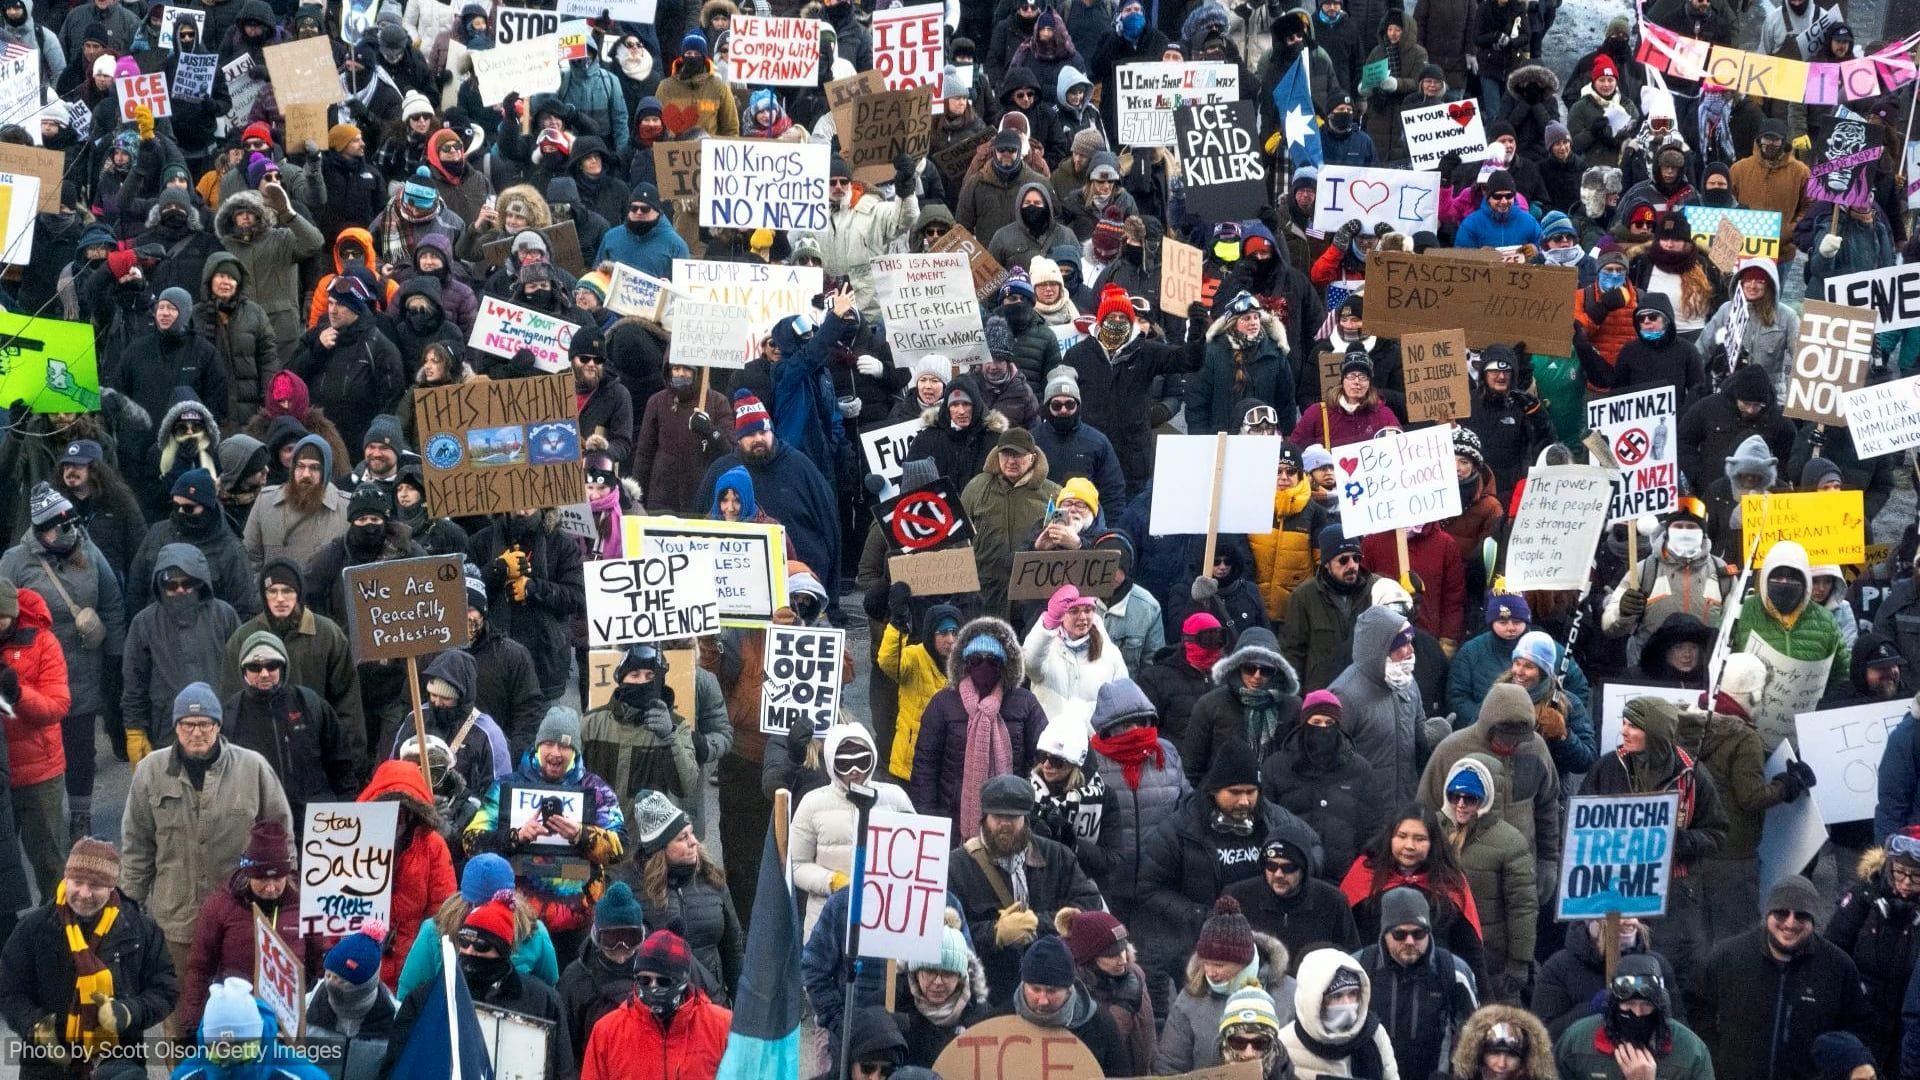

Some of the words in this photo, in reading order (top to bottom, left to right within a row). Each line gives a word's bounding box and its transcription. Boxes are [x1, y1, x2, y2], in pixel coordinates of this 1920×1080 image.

[499, 11, 559, 44] STOP
[732, 18, 759, 37] WE
[874, 18, 939, 53] ICE
[1805, 14, 1830, 42] ICE
[180, 55, 217, 67] JUSTICE
[875, 46, 942, 78] OUT
[123, 76, 166, 99] ICE
[856, 94, 931, 124] DEATH
[1190, 104, 1238, 130] ICE:
[1404, 114, 1416, 125] IN
[1417, 110, 1445, 124] YOUR
[1446, 107, 1477, 121] HEART
[853, 116, 928, 142] SQUADS
[1411, 132, 1433, 144] YOU
[1435, 127, 1466, 140] KNOW
[852, 144, 887, 165] OUT
[1187, 128, 1252, 157] PAID
[1412, 150, 1435, 163] THIS
[1447, 143, 1485, 159] WRONG
[714, 144, 738, 173] NO
[743, 144, 804, 183] Kings
[1183, 151, 1265, 187] KILLERS
[714, 174, 739, 197] NO
[743, 175, 825, 202] Tyrants
[711, 198, 753, 226] NO
[763, 201, 828, 231] NAZIS
[685, 263, 740, 281] TRUMP
[750, 264, 769, 282] IS
[787, 270, 799, 284] A
[909, 258, 920, 269] IS
[921, 258, 931, 268] A
[932, 258, 962, 269] MORAL
[1169, 244, 1199, 279] ICE
[906, 271, 946, 282] MOMENT.
[1507, 271, 1533, 290] IS
[899, 286, 912, 299] IT
[912, 286, 922, 298] IS
[925, 285, 946, 297] NOT
[1165, 275, 1200, 305] OUT
[680, 304, 705, 317] NOT
[711, 304, 747, 319] EVEN
[887, 302, 918, 321] LEFT
[920, 305, 934, 316] OR
[933, 300, 973, 316] RIGHT
[680, 321, 730, 334] HEATED
[919, 319, 933, 331] IT
[932, 318, 944, 330] IS
[1800, 312, 1875, 355] ICE
[680, 333, 723, 346] RIVALRY
[894, 332, 937, 350] RIGHT
[677, 346, 705, 359] HELPS
[1408, 343, 1425, 364] NO
[1432, 341, 1454, 357] ONE
[1795, 344, 1872, 384] OUT
[1407, 368, 1420, 385] IS
[1423, 363, 1461, 381] ILLEGAL
[416, 383, 479, 432] THIS
[487, 373, 578, 425] MACHINE
[1408, 388, 1423, 404] ON
[1423, 384, 1452, 403] STOLEN
[1849, 393, 1867, 407] NO
[1876, 387, 1893, 400] ICE
[1590, 404, 1607, 429] IF
[1609, 398, 1634, 425] NOT
[1635, 391, 1677, 420] NAZI,
[1853, 409, 1871, 423] NO
[1879, 400, 1912, 417] FEAR
[1861, 441, 1883, 455] ARE
[1529, 477, 1552, 494] The
[1554, 478, 1599, 495] power
[1637, 462, 1675, 491] NAZI
[429, 470, 501, 518] DEFEATS
[504, 461, 586, 509] TYRANNY
[1367, 501, 1397, 523] ICE
[1408, 487, 1448, 515] OUT
[1521, 497, 1537, 511] of
[1540, 496, 1558, 511] the
[1562, 499, 1604, 517] people
[1774, 498, 1793, 510] ICE
[1520, 516, 1530, 529] is
[1535, 516, 1587, 536] stronger
[655, 537, 684, 554] YOU
[719, 541, 752, 553] NOT
[1512, 534, 1535, 546] than
[1540, 534, 1559, 546] the
[715, 558, 751, 570] LESS
[1513, 549, 1545, 566] people
[1551, 549, 1563, 560] in
[600, 553, 689, 594] STOP
[1017, 559, 1081, 587] FUCK
[1081, 560, 1116, 587] ICE
[1523, 565, 1564, 581] power
[358, 579, 391, 602] We
[405, 576, 435, 597] Are
[624, 588, 675, 613] THE
[369, 599, 446, 626] Peacefully
[593, 601, 719, 642] VIOLENCE
[373, 625, 451, 647] Protesting
[775, 632, 836, 658] ICE
[773, 658, 835, 683] OUT
[792, 682, 834, 707] OF
[519, 792, 574, 813] FUK
[1573, 801, 1670, 829] DONTCHA
[312, 811, 362, 847] Stay
[866, 826, 945, 885] ICE
[1572, 826, 1667, 865] TREAD
[305, 840, 393, 897] Salty
[1567, 864, 1613, 899] ON
[1617, 862, 1663, 899] ME
[860, 880, 944, 938] OUT
